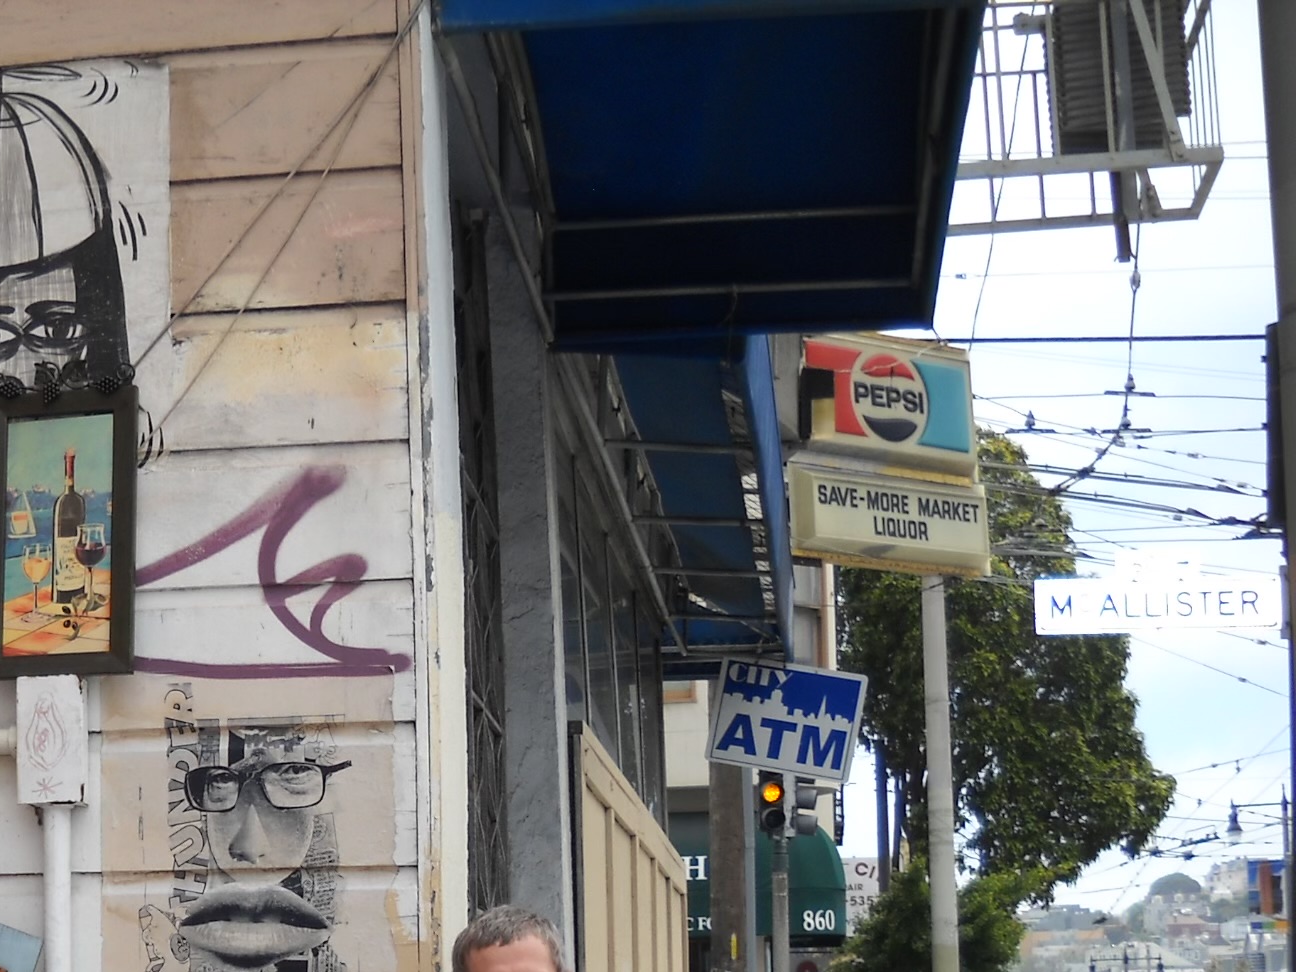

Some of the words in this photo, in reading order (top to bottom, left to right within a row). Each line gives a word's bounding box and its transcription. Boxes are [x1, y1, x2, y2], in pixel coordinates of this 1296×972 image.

[853, 381, 925, 414] PEPSI
[817, 484, 909, 515] SAVE-MORE
[918, 497, 980, 523] MARKET
[873, 515, 929, 541] LIQUOR
[1050, 590, 1259, 619] MALLISTER
[729, 663, 794, 688] CITY
[715, 712, 848, 771] ATM
[847, 883, 864, 891] AIR
[802, 909, 836, 932] 860
